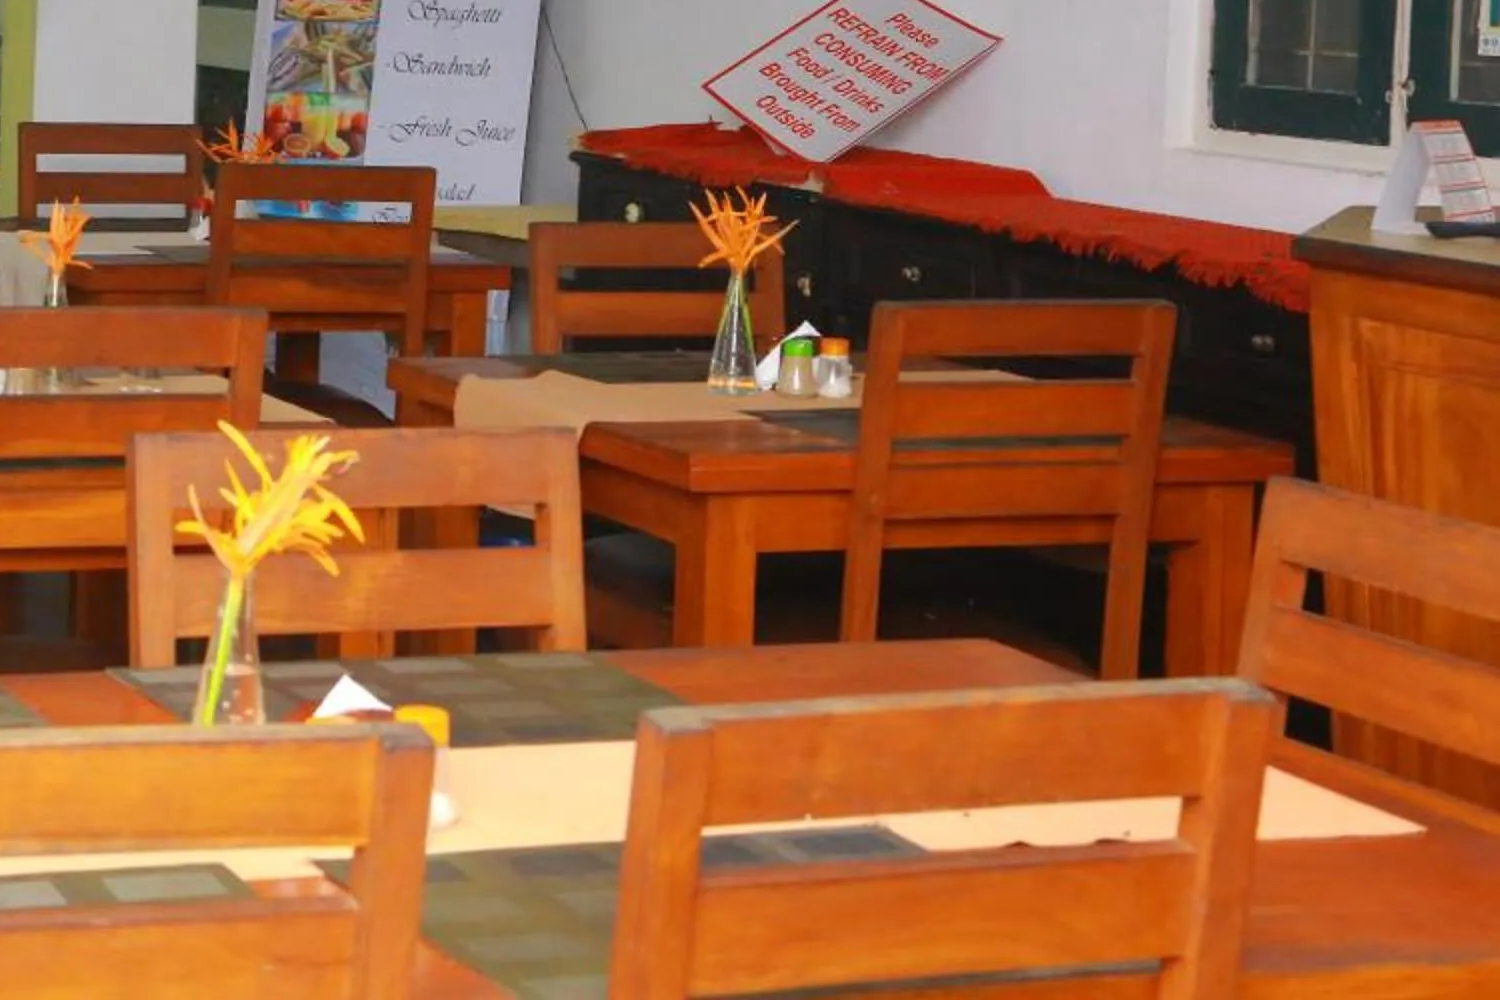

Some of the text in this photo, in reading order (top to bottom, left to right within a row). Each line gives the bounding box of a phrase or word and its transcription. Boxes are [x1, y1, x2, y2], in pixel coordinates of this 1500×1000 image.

[407, 0, 503, 28] Spaghetti
[886, 11, 940, 49] Please
[392, 52, 492, 78] Sandwich
[813, 32, 914, 95] CONSUMING
[827, 6, 951, 83] REFRAIN FROM
[759, 62, 863, 134] Brought From
[787, 46, 831, 82] Food
[833, 79, 885, 114] Drinks
[388, 115, 515, 147] Fresh Juice
[755, 95, 817, 139] Outside
